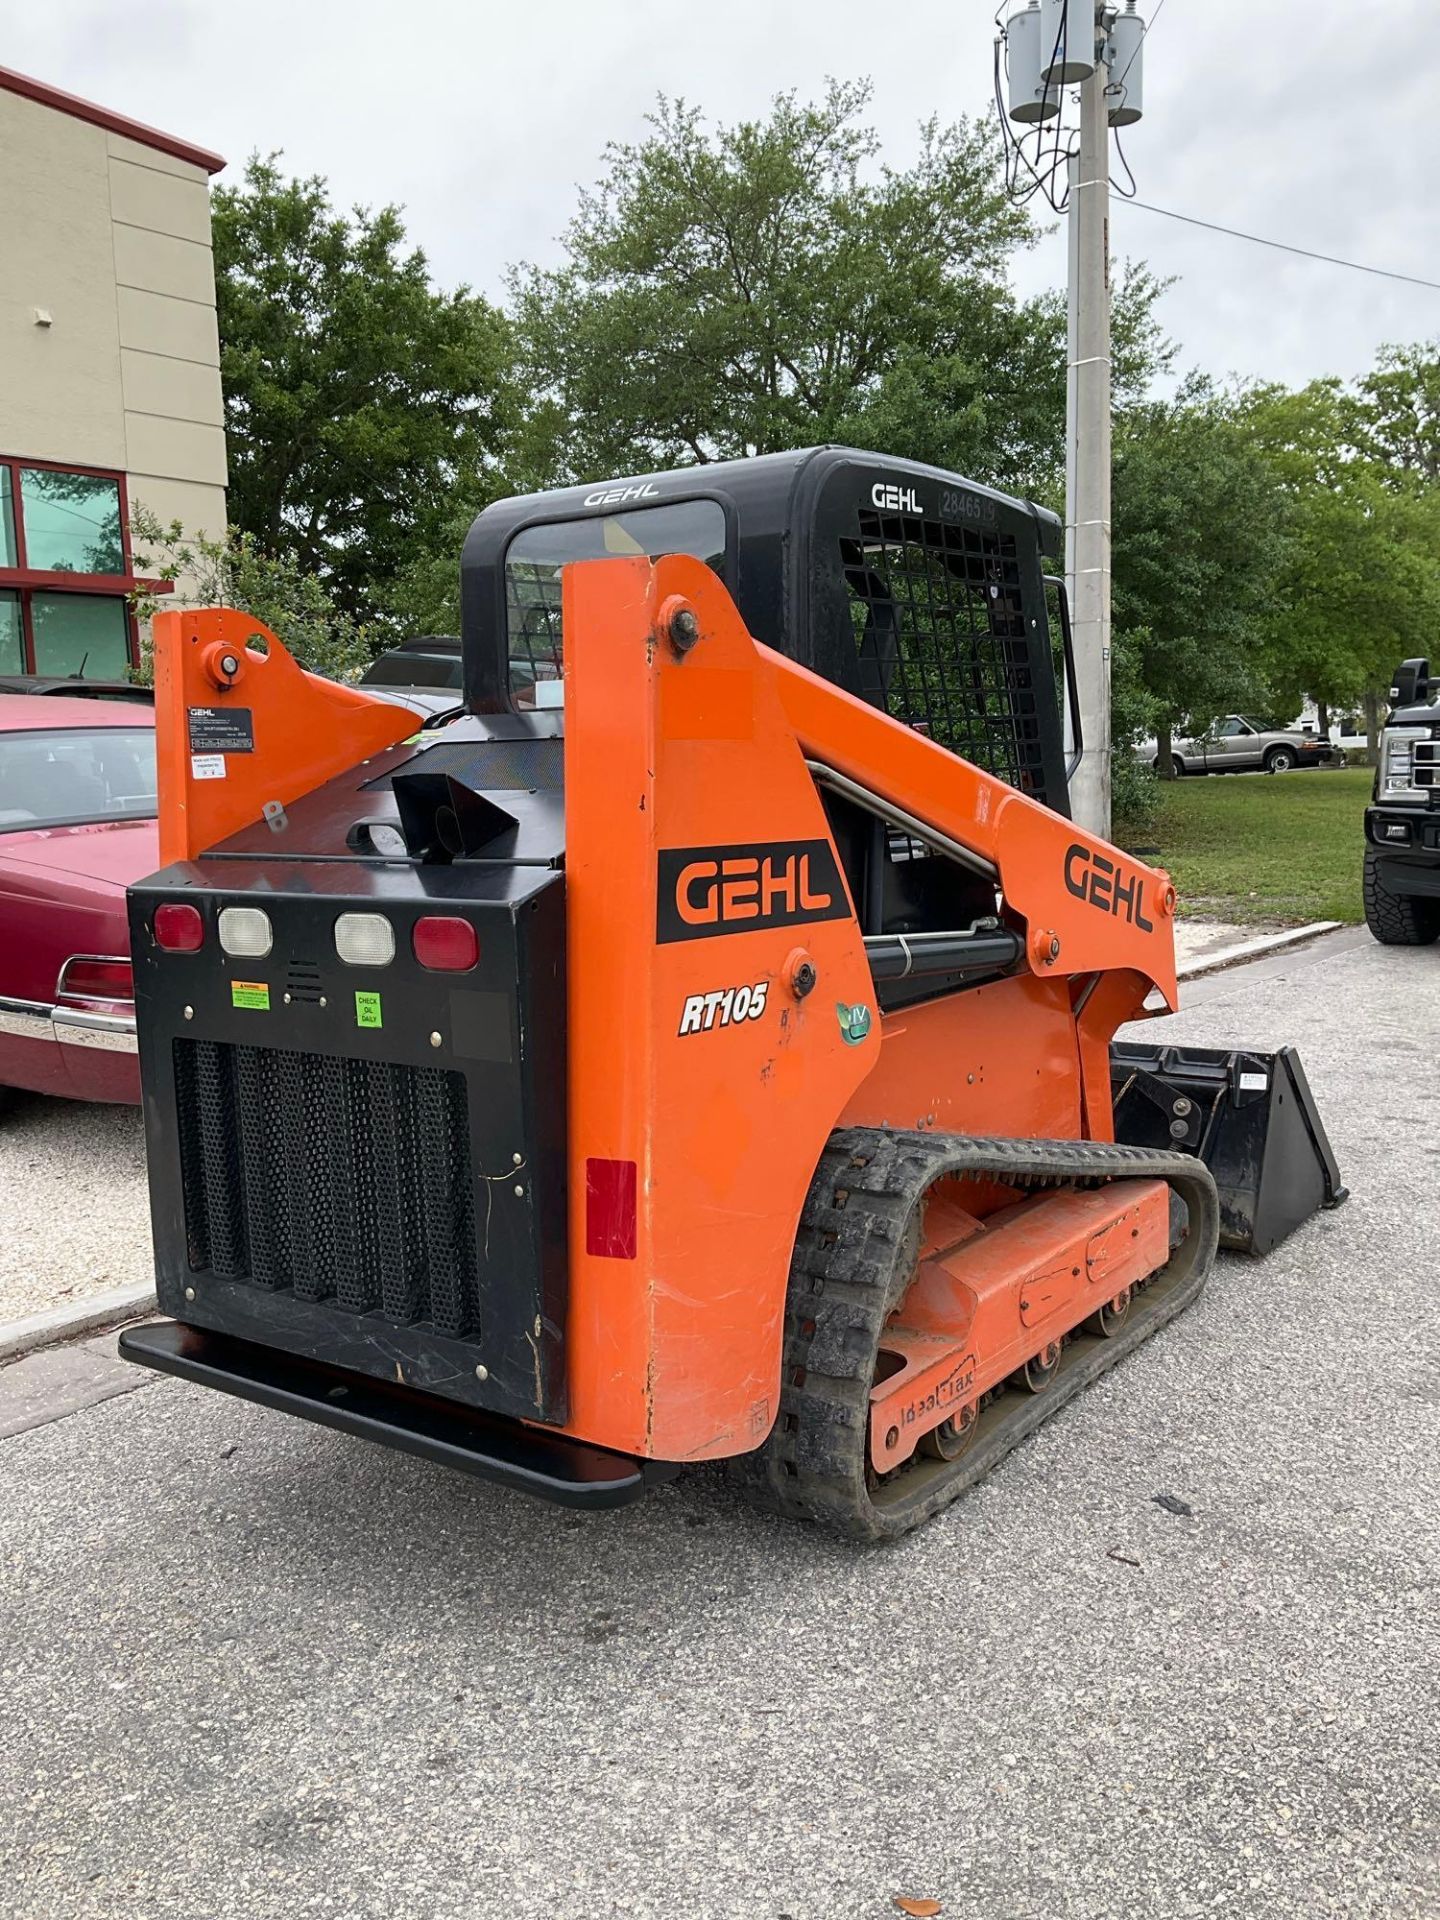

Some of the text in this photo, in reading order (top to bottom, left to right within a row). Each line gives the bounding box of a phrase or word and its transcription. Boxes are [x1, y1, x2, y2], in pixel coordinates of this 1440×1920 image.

[583, 483, 659, 507] GEHL
[871, 483, 924, 514] GEHL
[190, 708, 215, 716] GEHL
[675, 853, 832, 925] GEHL
[1064, 843, 1153, 934] GEHL
[358, 996, 377, 1005] CHECK
[363, 1006, 373, 1014] OIL
[677, 981, 770, 1037] RT105
[361, 1015, 377, 1023] DAILY
